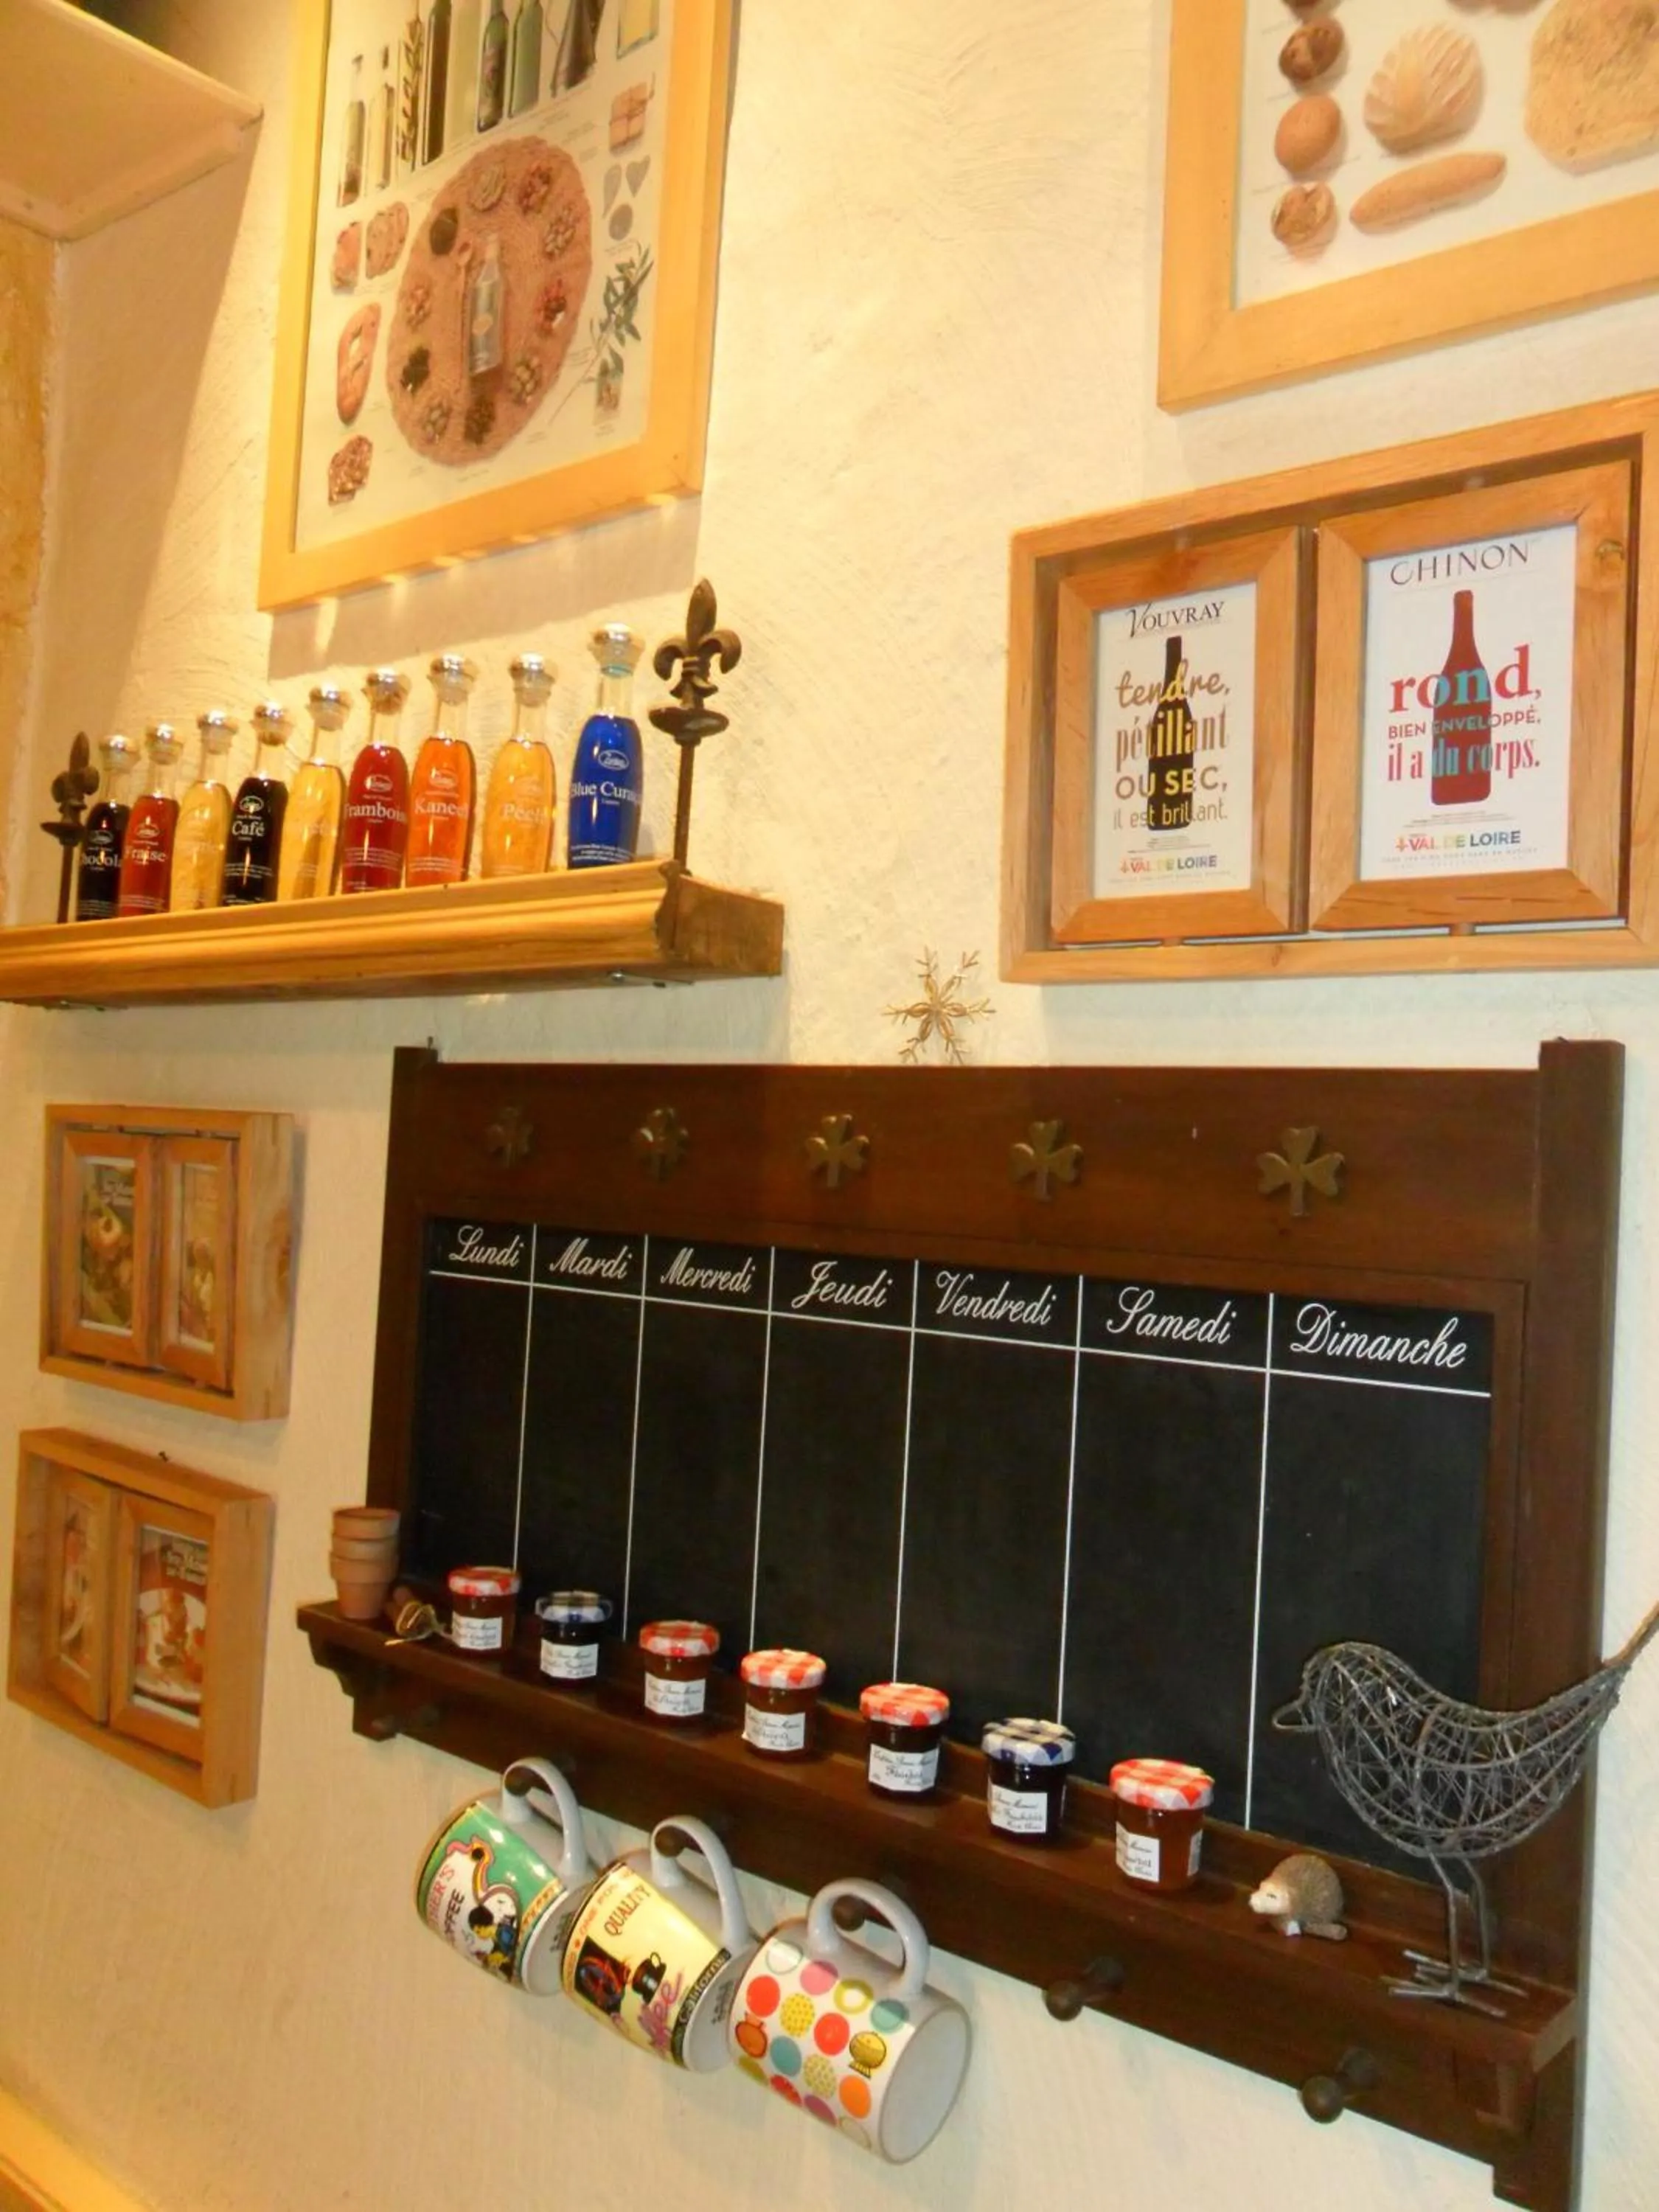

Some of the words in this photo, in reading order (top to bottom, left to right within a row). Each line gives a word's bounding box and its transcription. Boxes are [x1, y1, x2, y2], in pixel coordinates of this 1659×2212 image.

[1391, 543, 1530, 586] CHINON
[1125, 601, 1225, 638] VOUVRAY
[1115, 658, 1230, 708] tendre,
[1389, 643, 1542, 713] rond,
[1116, 706, 1228, 773] pétillant
[1388, 721, 1426, 740] BIEN
[1388, 742, 1402, 781] il
[1410, 751, 1423, 779] a
[1431, 737, 1459, 778] du
[1467, 738, 1540, 779] corps.
[1116, 773, 1155, 800] OU
[1165, 765, 1227, 795] SEC,
[232, 820, 265, 838] Café
[1113, 808, 1122, 830] il
[1130, 803, 1155, 827] est
[1409, 835, 1438, 852] VAL
[1470, 830, 1521, 848] LOIRE
[1178, 855, 1217, 870] LOIRE
[448, 1225, 524, 1267] Lundi
[549, 1237, 633, 1280] Mardi
[660, 1248, 757, 1294] Mercredi
[791, 1260, 894, 1309] Jeudi
[935, 1270, 1057, 1326] Vendredi
[1107, 1286, 1237, 1346] Samedi
[1290, 1302, 1467, 1369] Dimanche
[603, 1884, 651, 1937] QUALITY
